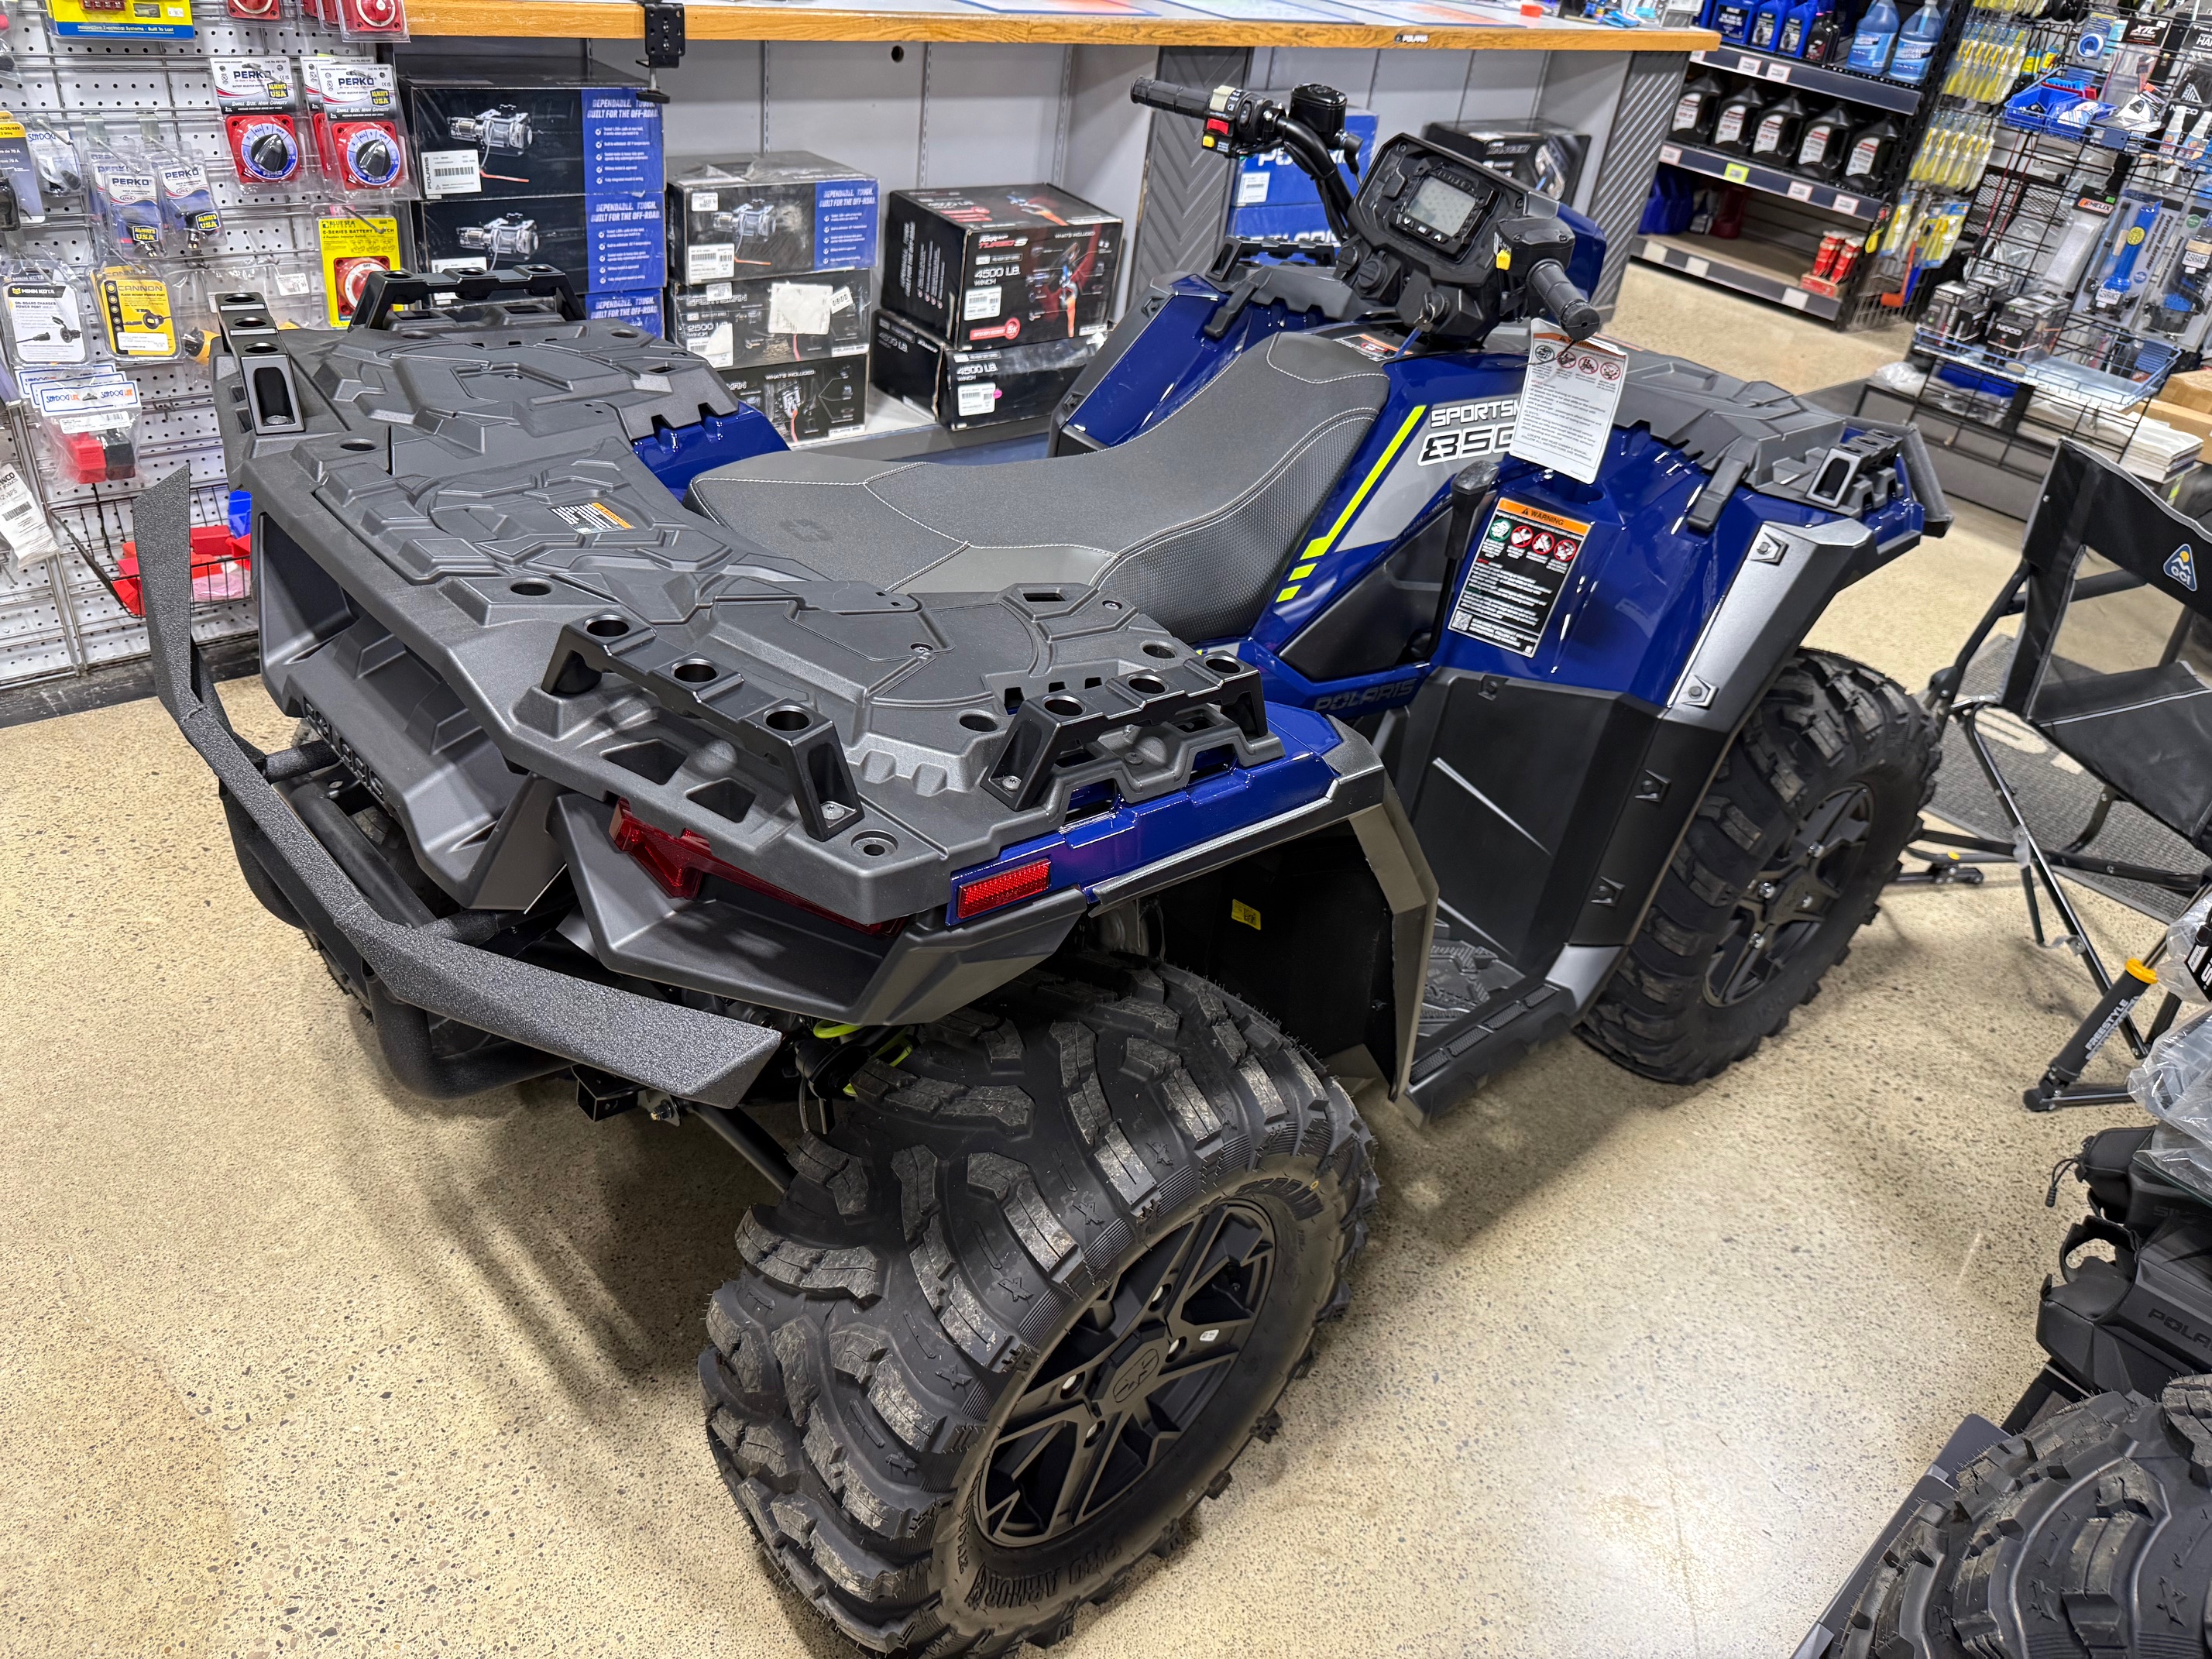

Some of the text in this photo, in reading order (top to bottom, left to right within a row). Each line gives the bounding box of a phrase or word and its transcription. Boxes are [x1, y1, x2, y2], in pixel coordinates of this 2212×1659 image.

[2132, 25, 2161, 34] XTC
[233, 70, 271, 79] PERKO
[592, 99, 632, 108] DEPENDABLE.
[587, 110, 605, 118] BUILT
[2169, 104, 2199, 115] NCO
[165, 170, 199, 180] PERKO
[596, 202, 634, 212] DEPENDABLE.
[591, 213, 607, 222] BUILT
[608, 212, 620, 222] FOR
[621, 212, 631, 221] THE
[979, 237, 1029, 249] TURBO S
[974, 265, 1021, 279] 4500 LB.
[974, 278, 996, 287] WINCH
[596, 300, 632, 310] DEPENDABLE.
[591, 310, 607, 319] BUILT
[608, 309, 619, 318] FOR
[620, 308, 630, 317] THE
[687, 324, 714, 332] 2500
[1996, 323, 2023, 336] NOCO
[957, 362, 998, 375] 4500 LB.
[1417, 423, 1516, 465] 850
[0, 472, 15, 486] NCO
[1530, 510, 1564, 526] WARNING
[2171, 566, 2191, 586] GCI
[1314, 678, 1417, 711] POLARIS
[2085, 999, 2128, 1050] FREESTYLE
[2148, 1307, 2212, 1352] POLA
[985, 1567, 1063, 1609] ARMOR
